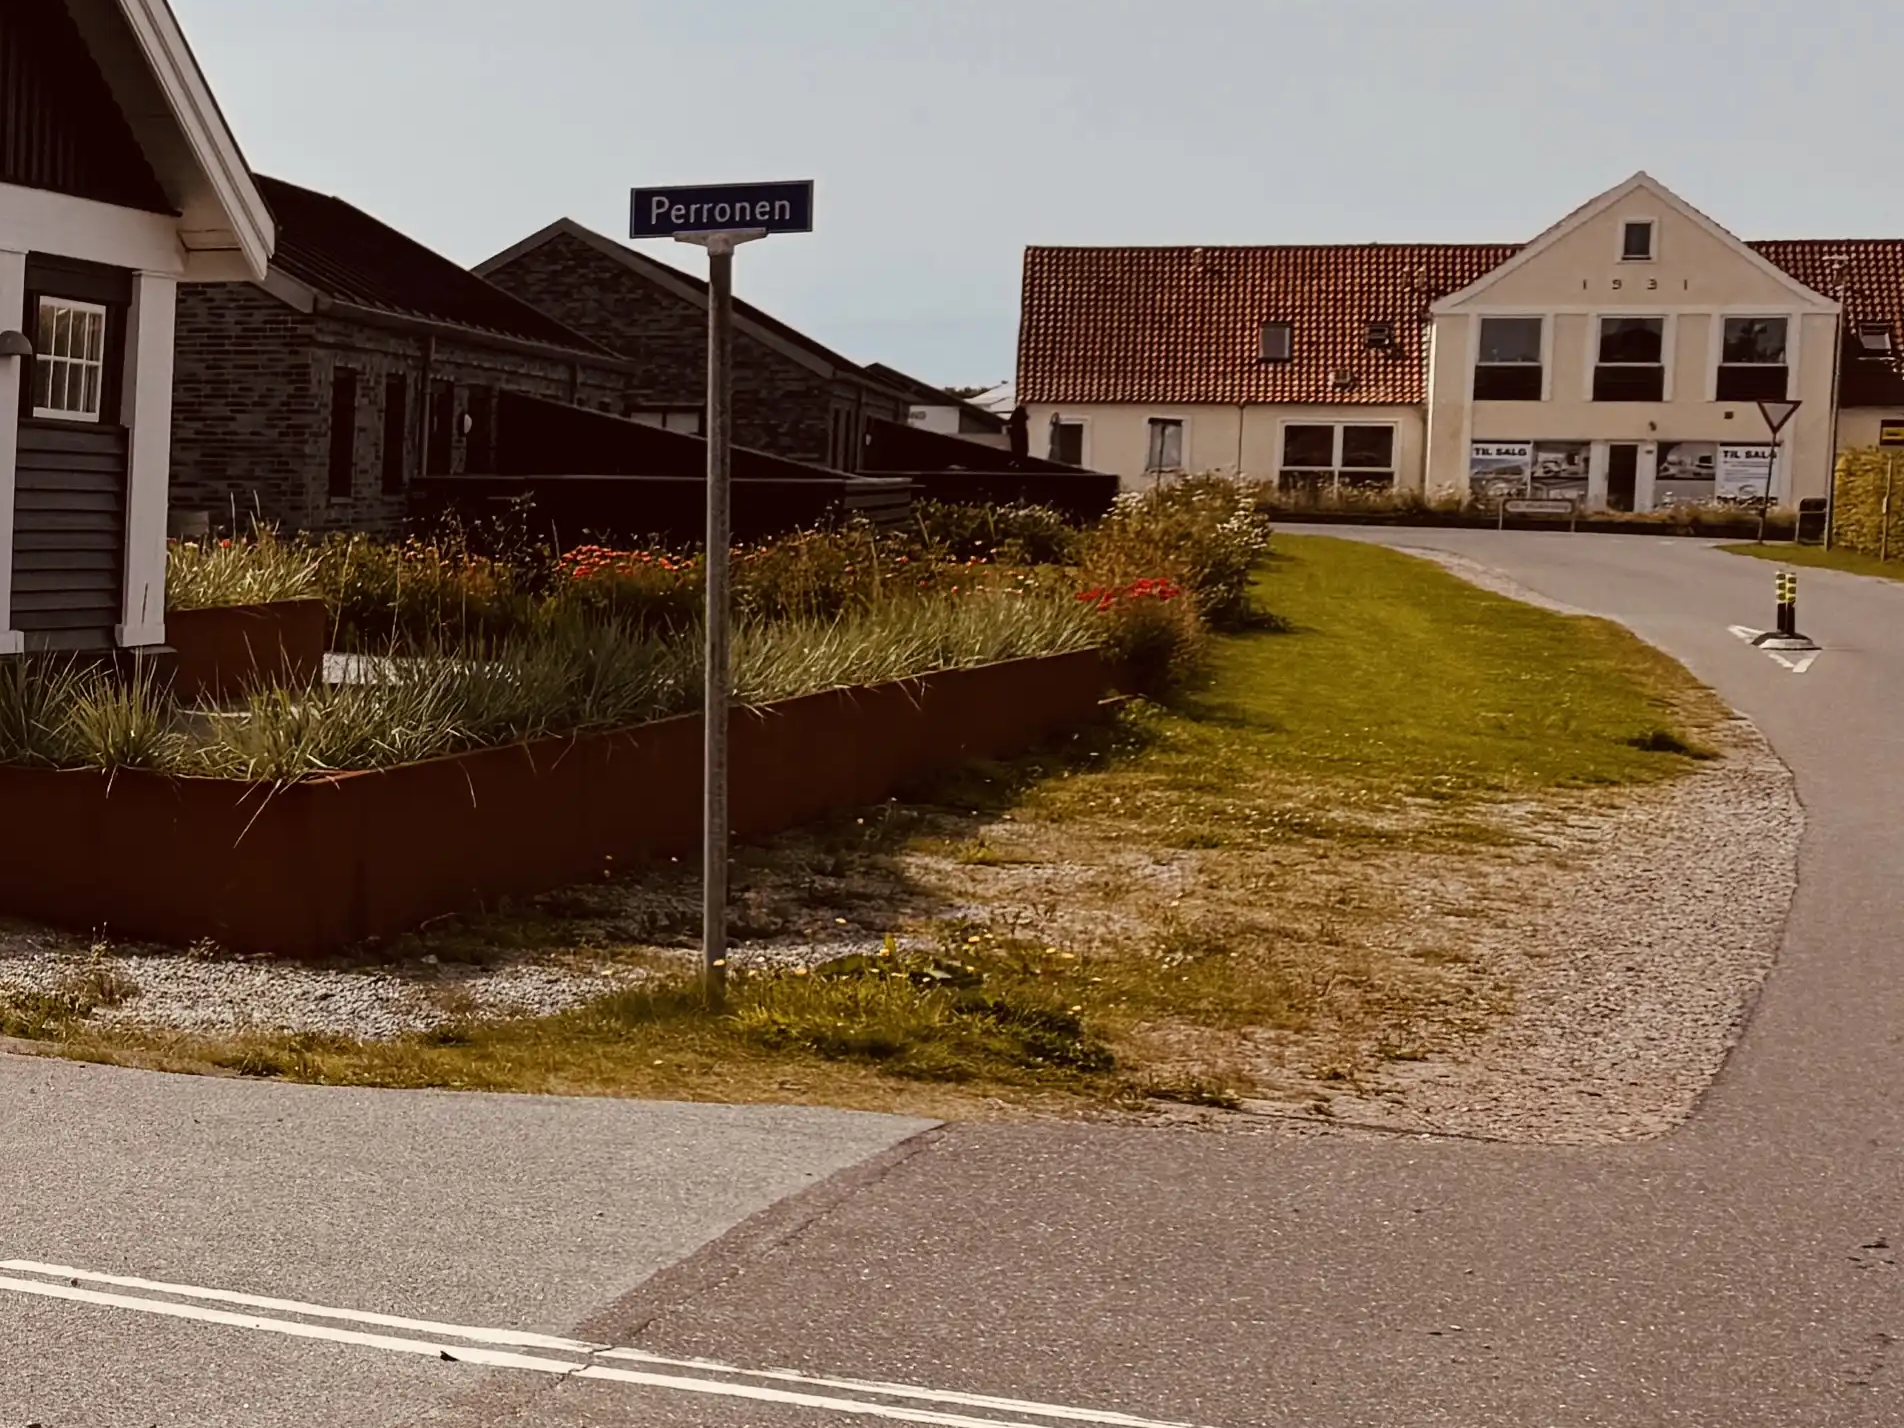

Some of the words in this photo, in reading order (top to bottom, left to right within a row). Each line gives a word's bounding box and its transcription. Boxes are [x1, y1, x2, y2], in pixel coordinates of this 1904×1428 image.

[651, 196, 790, 224] Perronen
[1582, 278, 1688, 291] 1931
[1474, 447, 1492, 456] TIL
[1495, 447, 1527, 457] SALG
[1723, 450, 1740, 459] TIL
